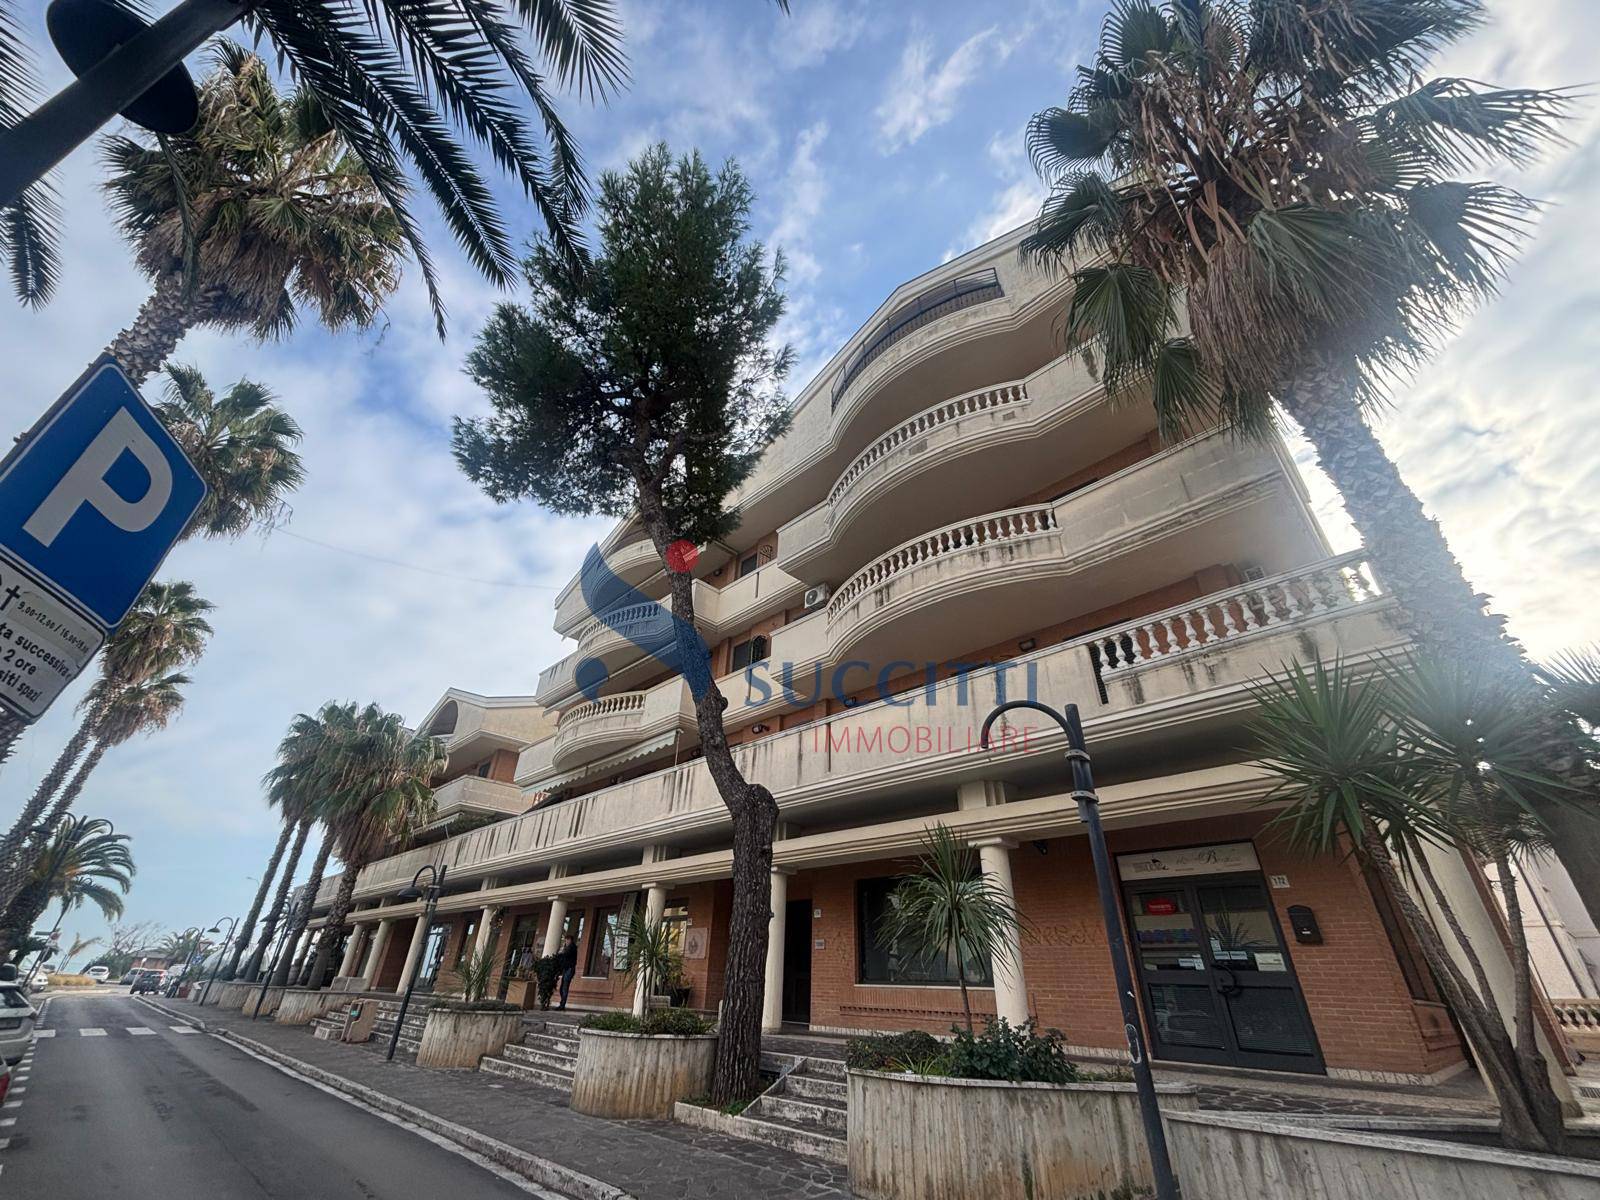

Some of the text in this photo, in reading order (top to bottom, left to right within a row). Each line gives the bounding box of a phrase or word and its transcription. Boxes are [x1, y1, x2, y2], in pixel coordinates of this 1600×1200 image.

[22, 406, 173, 548] P
[3, 649, 37, 675] 2 ore
[15, 635, 69, 677] successiva
[17, 683, 42, 702] spazi
